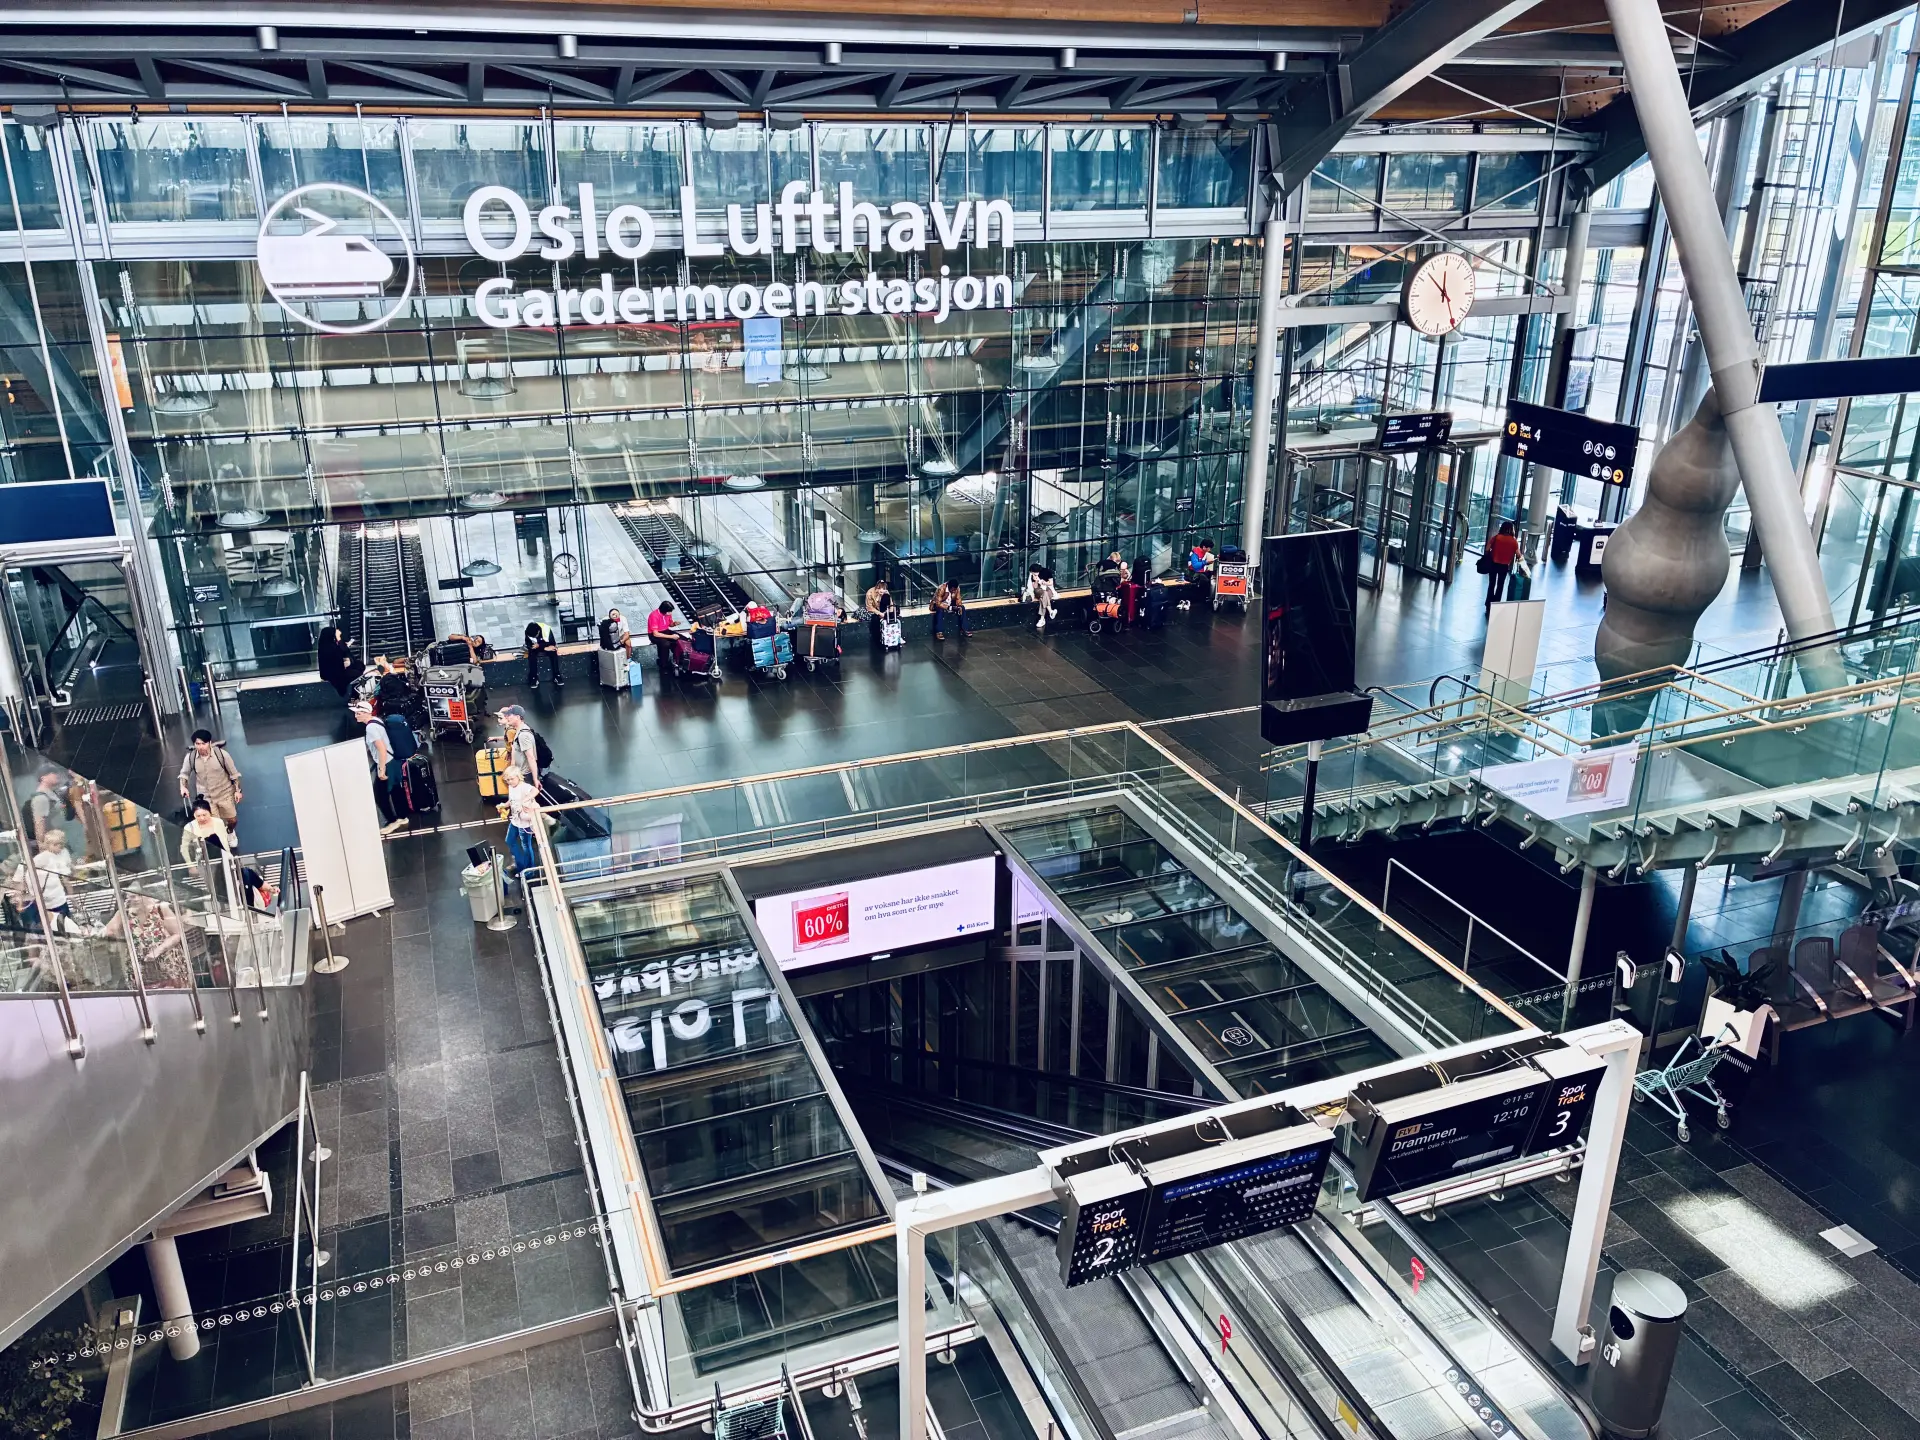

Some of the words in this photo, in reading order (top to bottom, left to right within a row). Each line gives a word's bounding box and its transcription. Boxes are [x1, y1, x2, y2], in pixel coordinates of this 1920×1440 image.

[464, 182, 655, 261] Oslo
[680, 180, 1014, 256] Lufthavn
[475, 273, 825, 328] Gardermoen
[840, 264, 1013, 324] stasjon
[1436, 428, 1444, 440] 4
[1520, 422, 1531, 432] Spor
[1534, 428, 1541, 442] 4
[826, 902, 848, 911] DISTILL
[874, 900, 900, 910] voksne
[914, 894, 930, 903] ikke
[931, 888, 959, 900] snakket
[878, 911, 891, 919] hva
[917, 904, 928, 912] for
[928, 901, 944, 910] mye
[804, 911, 842, 938] 60%
[1558, 1092, 1586, 1106] Track
[1560, 1084, 1587, 1098] Spor
[1493, 1106, 1529, 1124] 12:10
[1548, 1110, 1571, 1136] 3
[1392, 1128, 1456, 1152] Drammen
[1092, 1216, 1127, 1234] Track
[1093, 1208, 1125, 1224] Spor
[1092, 1238, 1114, 1266] 2
